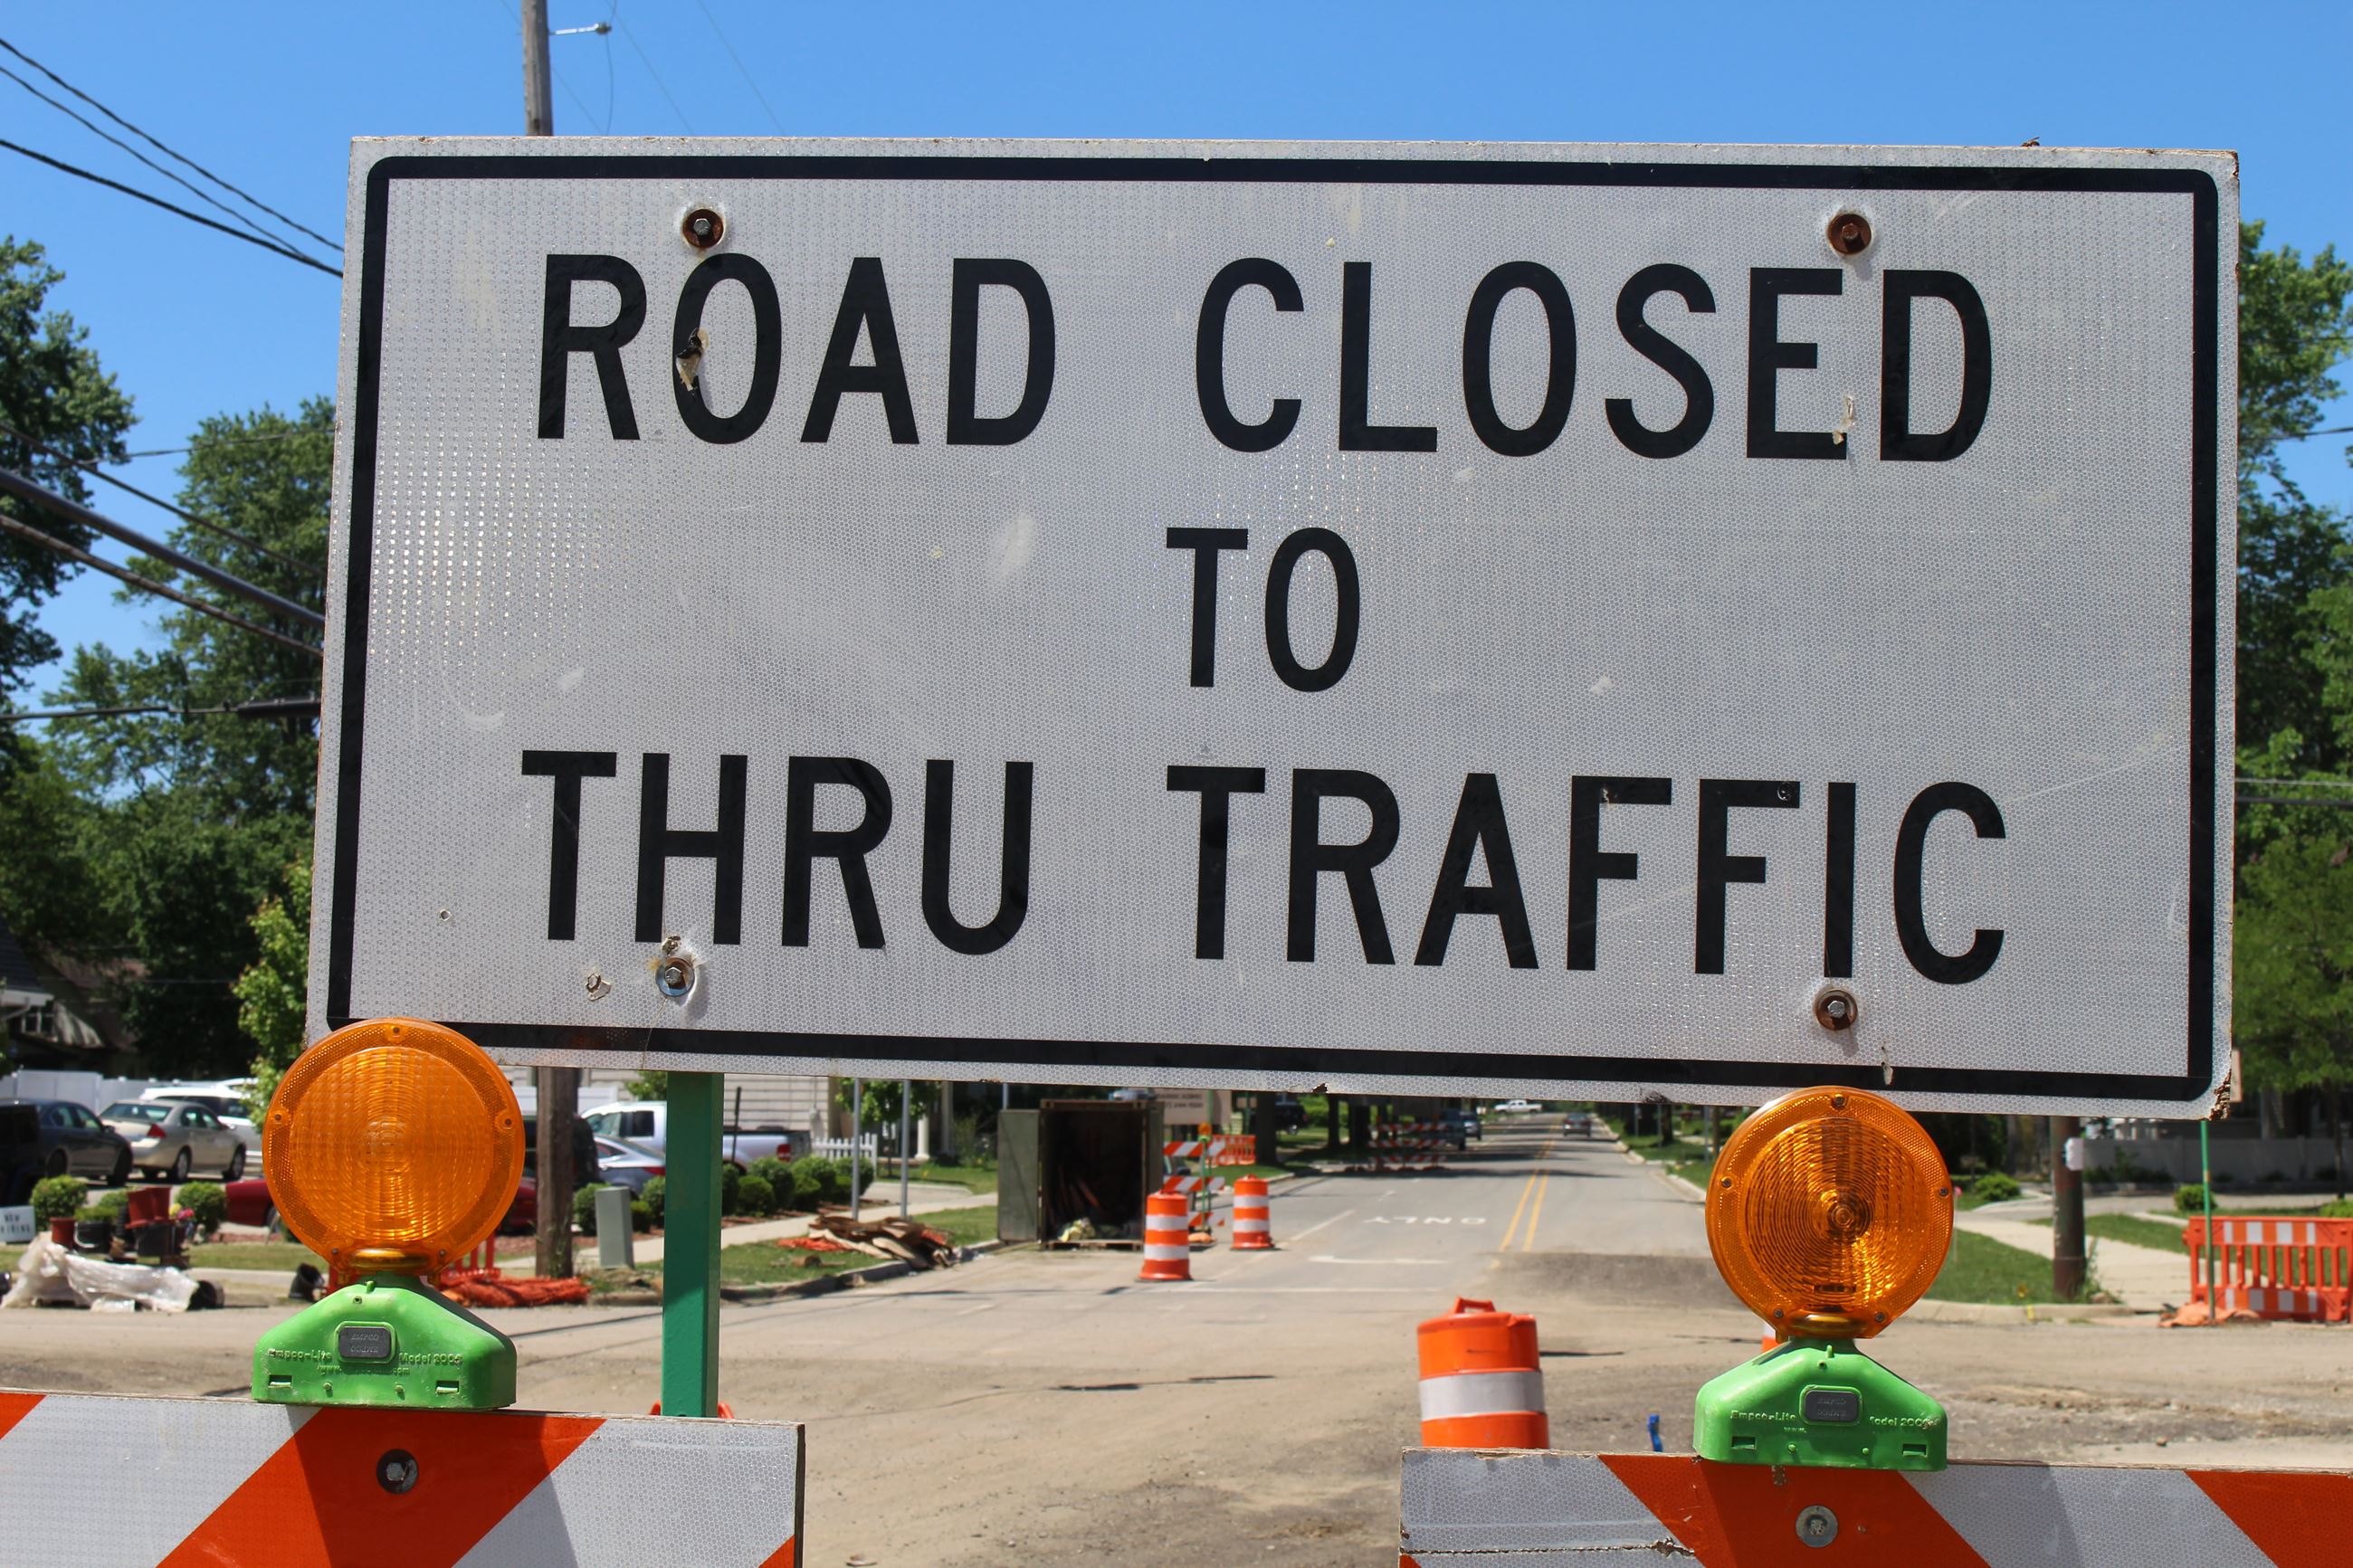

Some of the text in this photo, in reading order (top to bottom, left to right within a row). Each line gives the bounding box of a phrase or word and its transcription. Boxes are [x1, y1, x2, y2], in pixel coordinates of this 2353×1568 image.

[538, 254, 1992, 461] ROAD CLOSED
[1167, 527, 1359, 692] TO
[521, 750, 2005, 984] THRU TRAFFIC
[1363, 1216, 1487, 1224] ONLY
[398, 1352, 431, 1364] Model
[1730, 1410, 1796, 1421] Empco-Lite
